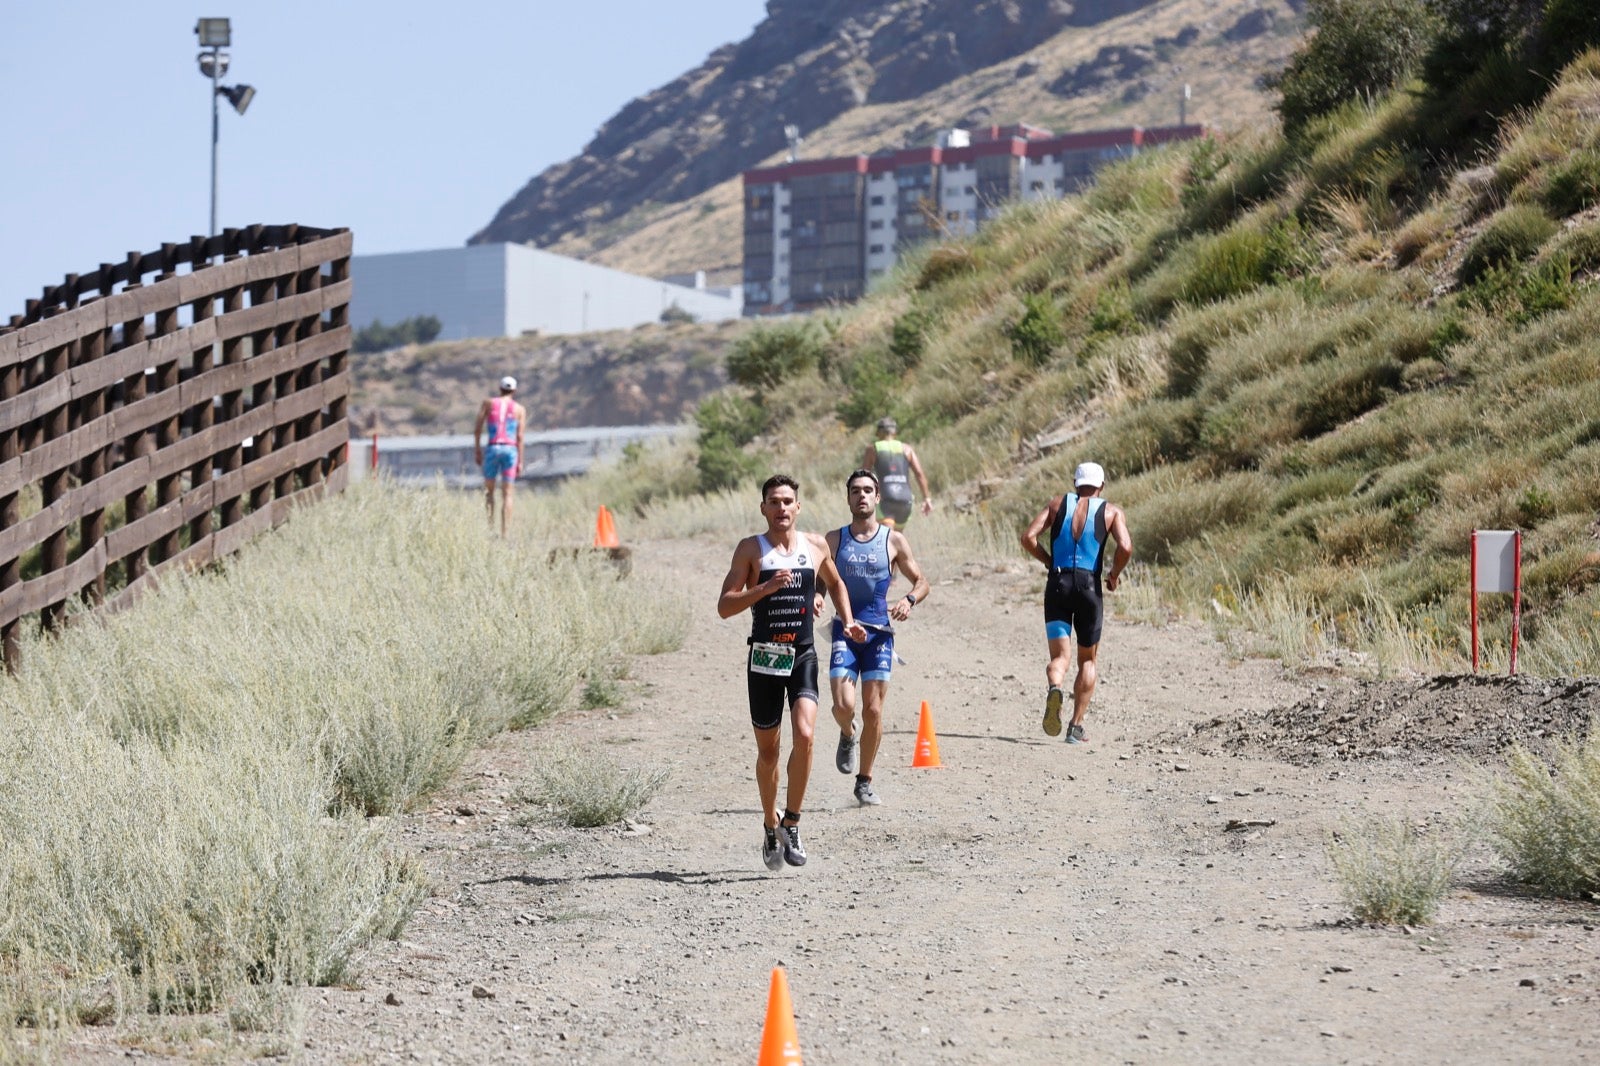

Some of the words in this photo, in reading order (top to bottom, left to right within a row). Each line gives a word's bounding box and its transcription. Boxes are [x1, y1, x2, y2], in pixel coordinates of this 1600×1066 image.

[848, 553, 877, 563] ADS
[768, 608, 800, 616] LASERGRAN
[772, 633, 797, 643] HSN
[768, 653, 779, 667] 7
